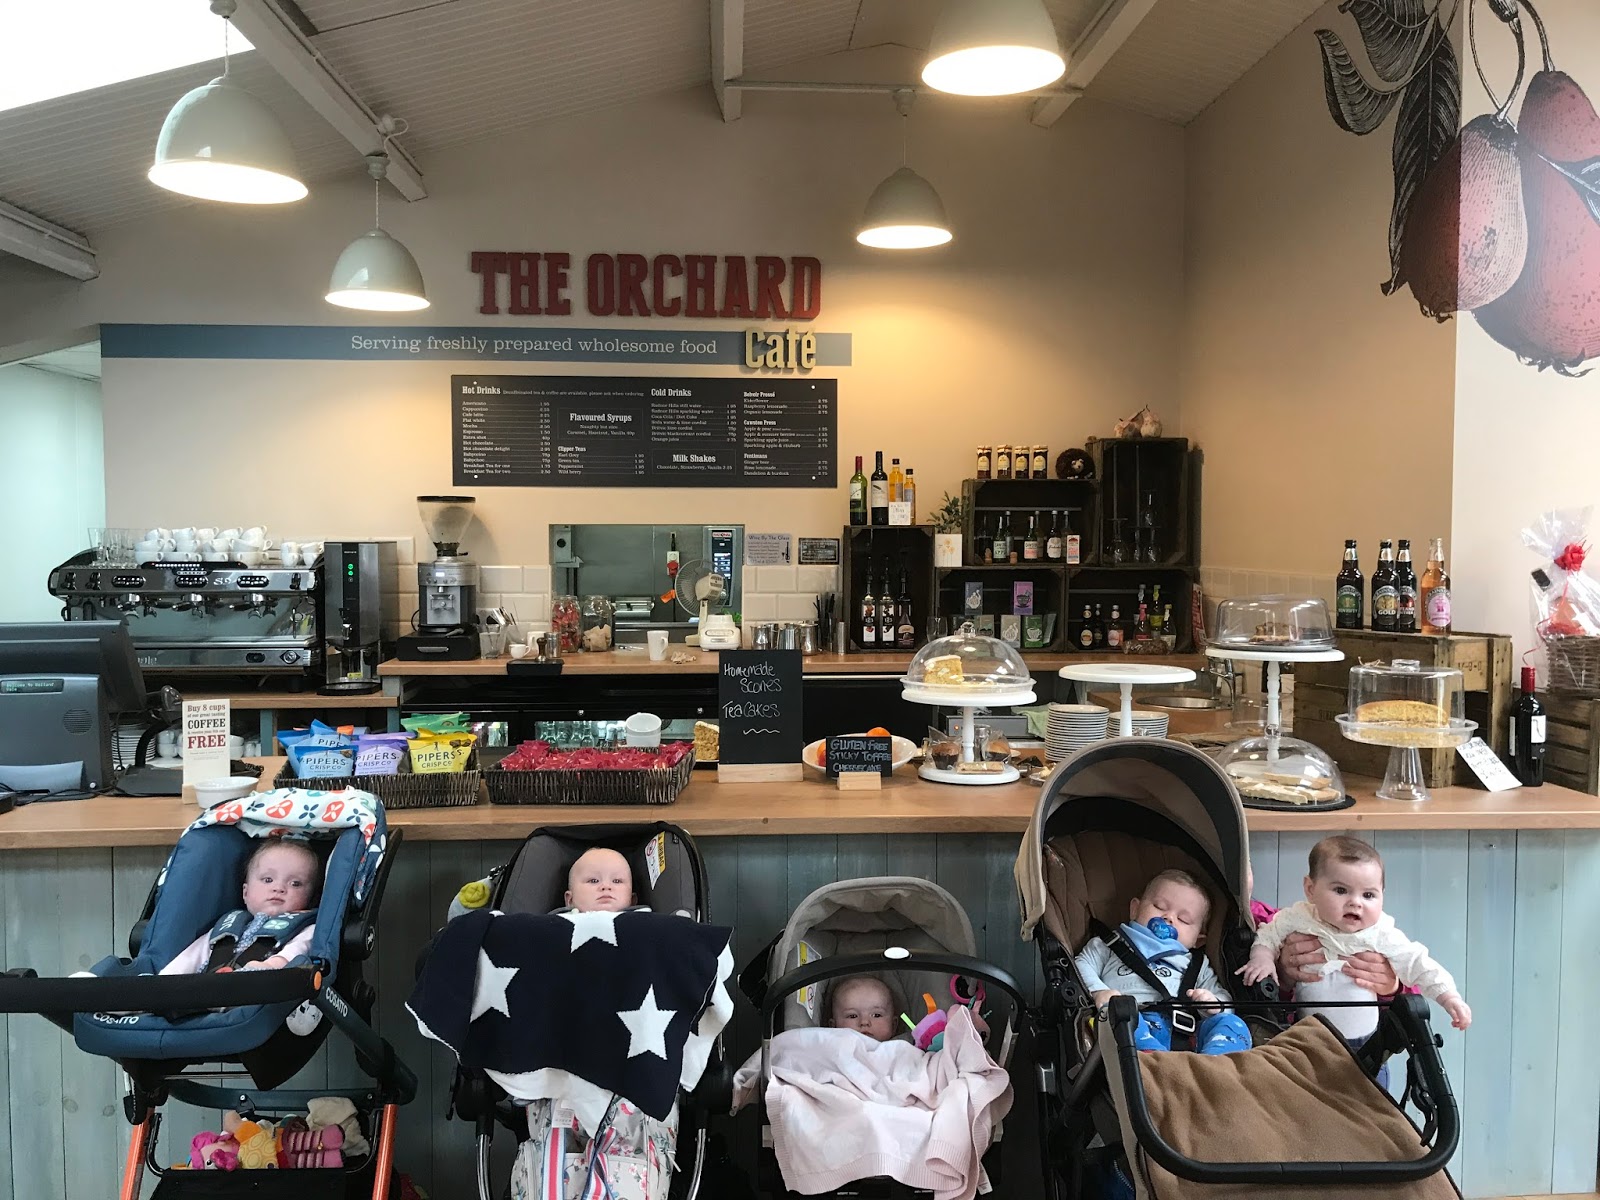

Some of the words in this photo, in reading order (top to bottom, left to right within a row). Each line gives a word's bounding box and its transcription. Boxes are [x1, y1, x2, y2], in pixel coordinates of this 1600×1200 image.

[471, 252, 571, 315] THE
[587, 253, 821, 320] ORCHARD
[351, 335, 422, 352] Serving
[427, 335, 488, 353] freshly
[493, 336, 573, 354] prepared
[578, 337, 675, 354] wholesome
[679, 339, 717, 355] food
[745, 326, 817, 368] Café
[462, 386, 475, 395] Hot
[476, 386, 501, 395] Drinks
[651, 388, 666, 397] Cold
[668, 388, 692, 397] Drinks
[570, 412, 606, 422] Flavoured
[607, 413, 632, 423] Syrups
[672, 454, 689, 463] Milk
[690, 454, 716, 463] Shakes
[724, 661, 775, 677] Homemade
[187, 705, 201, 713] Buy
[209, 704, 226, 712] cups
[188, 718, 226, 730] COFFEE
[188, 734, 226, 749] FREE
[830, 739, 867, 750] GLUTEN
[356, 752, 397, 762] PIPERS
[418, 751, 456, 762] PIPERS
[829, 750, 860, 760] STICKY
[306, 758, 346, 766] PIPERS
[326, 986, 348, 1017] COSATTO
